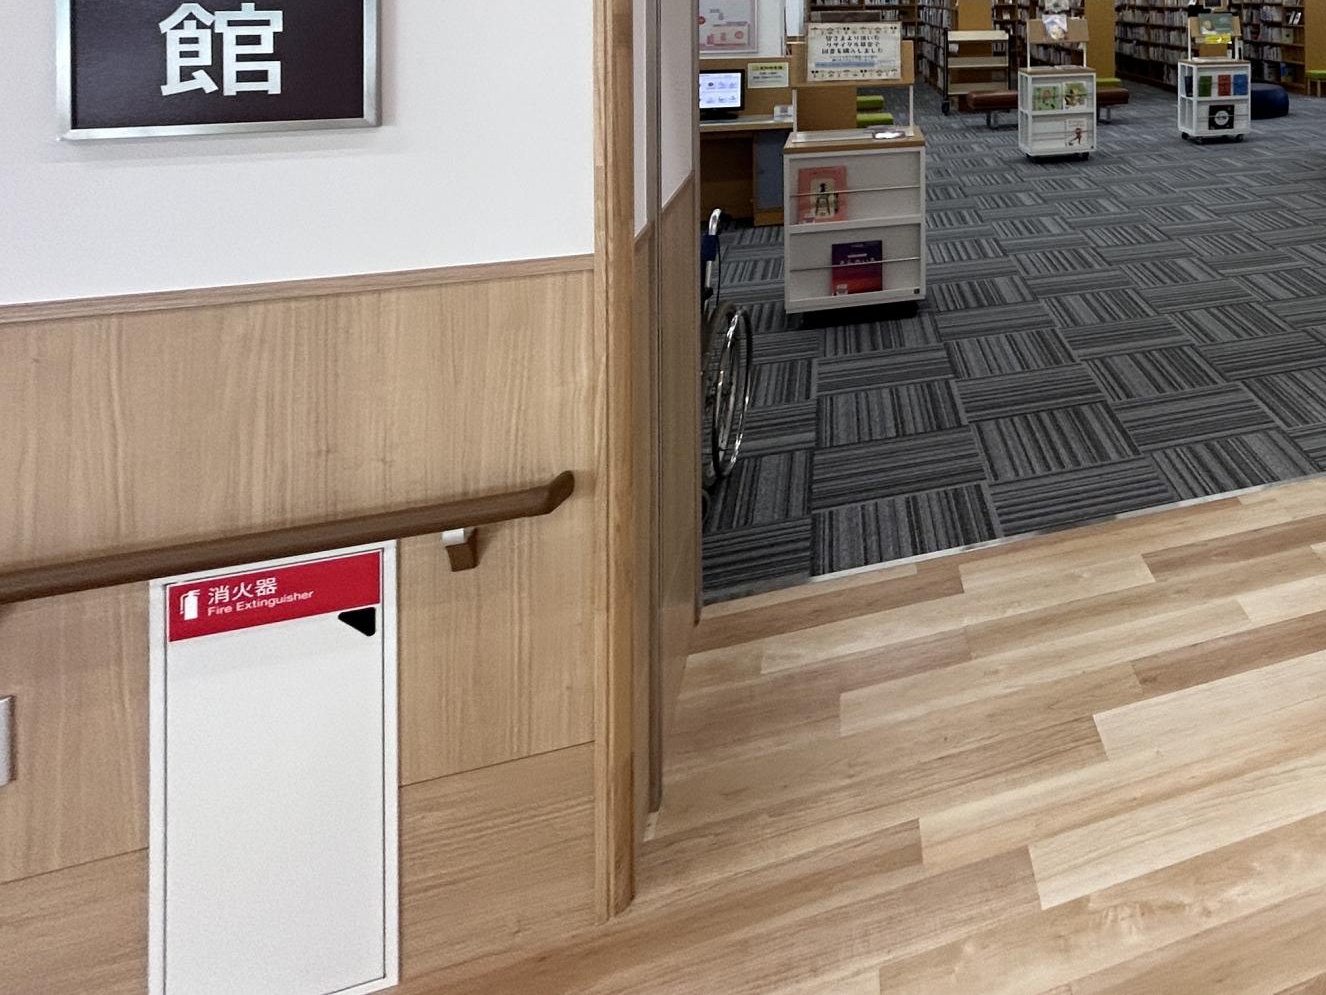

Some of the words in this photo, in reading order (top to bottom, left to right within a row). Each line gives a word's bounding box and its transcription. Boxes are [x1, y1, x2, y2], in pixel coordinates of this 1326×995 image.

[207, 577, 278, 605] 消火器
[207, 603, 232, 616] Fire
[236, 590, 314, 611] Extinguisher
